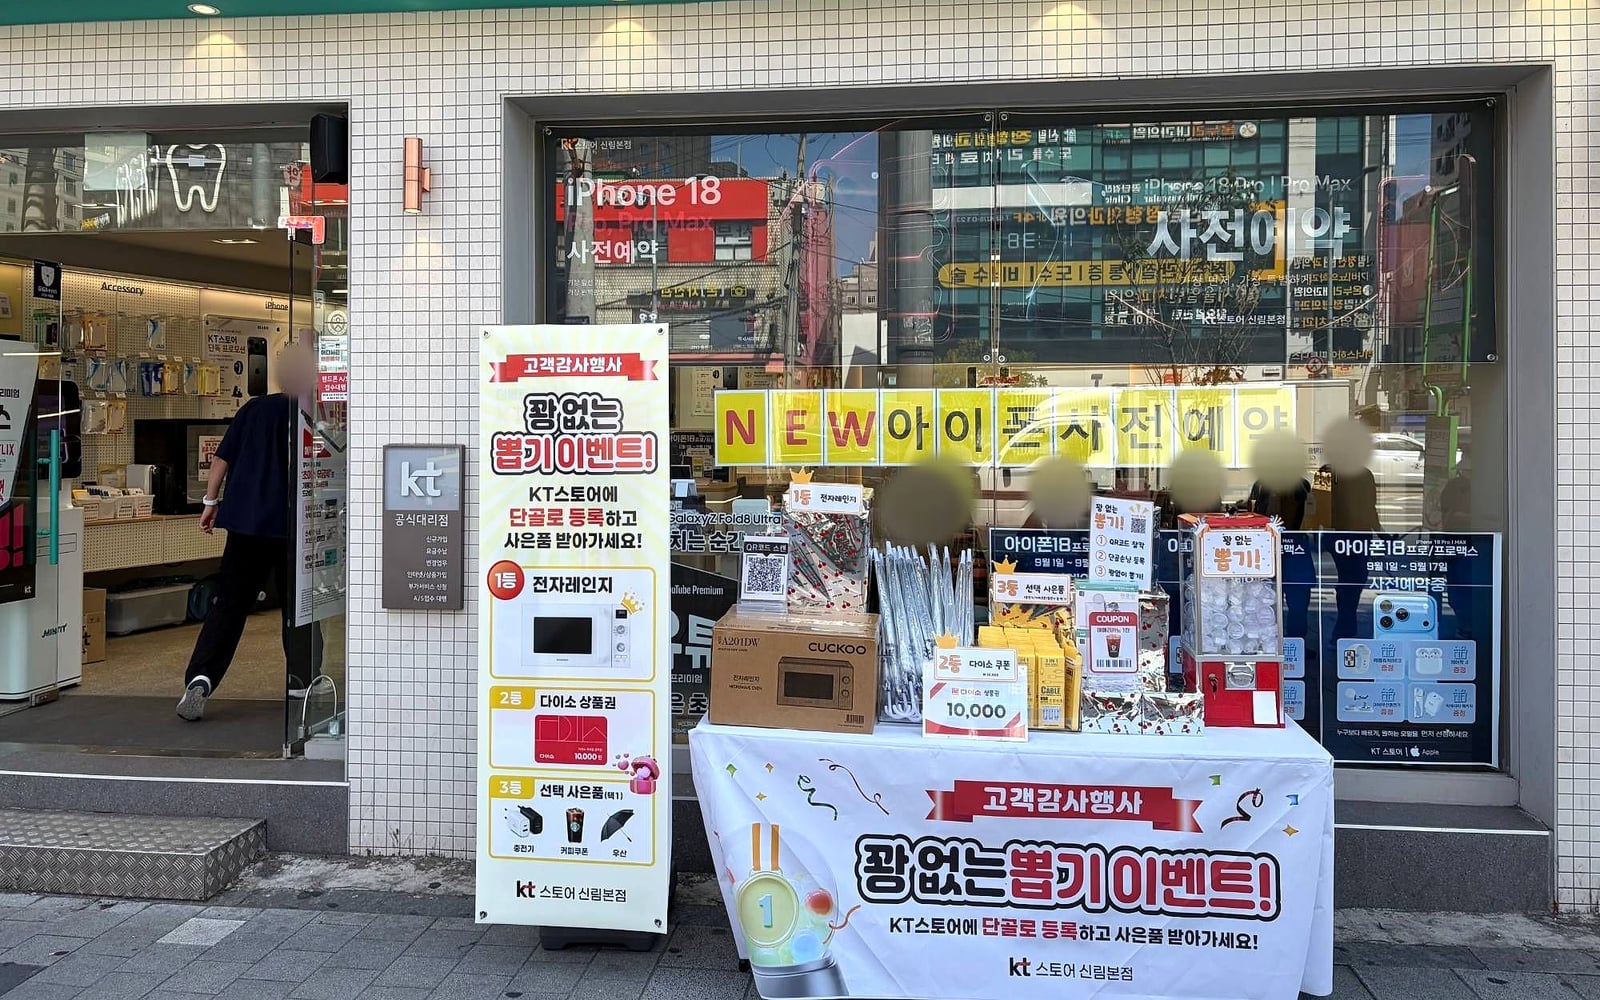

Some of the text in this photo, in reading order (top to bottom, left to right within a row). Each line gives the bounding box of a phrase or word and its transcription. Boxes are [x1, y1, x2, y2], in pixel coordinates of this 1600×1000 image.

[567, 177, 676, 207] iPhone
[684, 175, 721, 206] 18
[1315, 175, 1352, 192] Max
[663, 211, 714, 233] Max
[1147, 206, 1351, 262] 사전예약
[567, 240, 659, 265] 사전예약
[101, 281, 144, 297] Accessory
[265, 301, 289, 311] iPhone
[523, 356, 622, 373] 고객감사행사
[494, 435, 655, 471] 뽑기 이벤트!
[401, 461, 442, 497] kt
[529, 486, 618, 503] KT스토어에
[793, 489, 857, 506] 1등 전자레인지
[394, 513, 449, 528] 공식대리점
[509, 507, 638, 528] 단골로 등록하고
[719, 513, 751, 525] Fold8
[753, 513, 781, 525] Ultra
[1095, 512, 1125, 531] 뽑기!
[425, 535, 448, 543] 신규가입
[504, 532, 642, 550] 사은품 받아가세요!
[746, 543, 771, 552] QR코드
[1034, 558, 1052, 568] 9월
[1052, 558, 1065, 568] 1일
[1213, 548, 1261, 572] 뽑기!
[1367, 562, 1384, 572] 9월
[1386, 562, 1399, 572] 1일
[1410, 562, 1427, 572] 9월
[1429, 562, 1448, 572] 17일
[24, 585, 32, 594] kt
[494, 572, 614, 594] 1등 전자레인지
[692, 586, 724, 596] Premium
[997, 580, 1065, 597] 3등 선택 사은품
[1369, 576, 1446, 592] 사전예약중
[1096, 615, 1130, 623] COUPON
[722, 637, 760, 648] A201DW
[808, 642, 867, 656] CUCKOO
[938, 654, 1011, 673] 2등 다이소 쿠폰
[500, 691, 616, 710] 2등 다이소 상품권
[946, 702, 1006, 719] 10,000
[1371, 747, 1440, 757] KT 스토어 Apple
[499, 781, 565, 799] 3등 선택
[983, 786, 1143, 815] 고객감사행사
[513, 844, 627, 858] 충전기 커피쿠폰 우산
[1009, 847, 1102, 905] 뽑기
[1112, 855, 1272, 912] 이벤트!
[516, 881, 627, 902] kt 스토어 신림본점
[759, 895, 773, 928] 1
[890, 917, 1259, 951] KT스토어에 단골로 등록하고 사은품 받아가세요!
[1009, 957, 1133, 981] kt 스토어 신림본점
